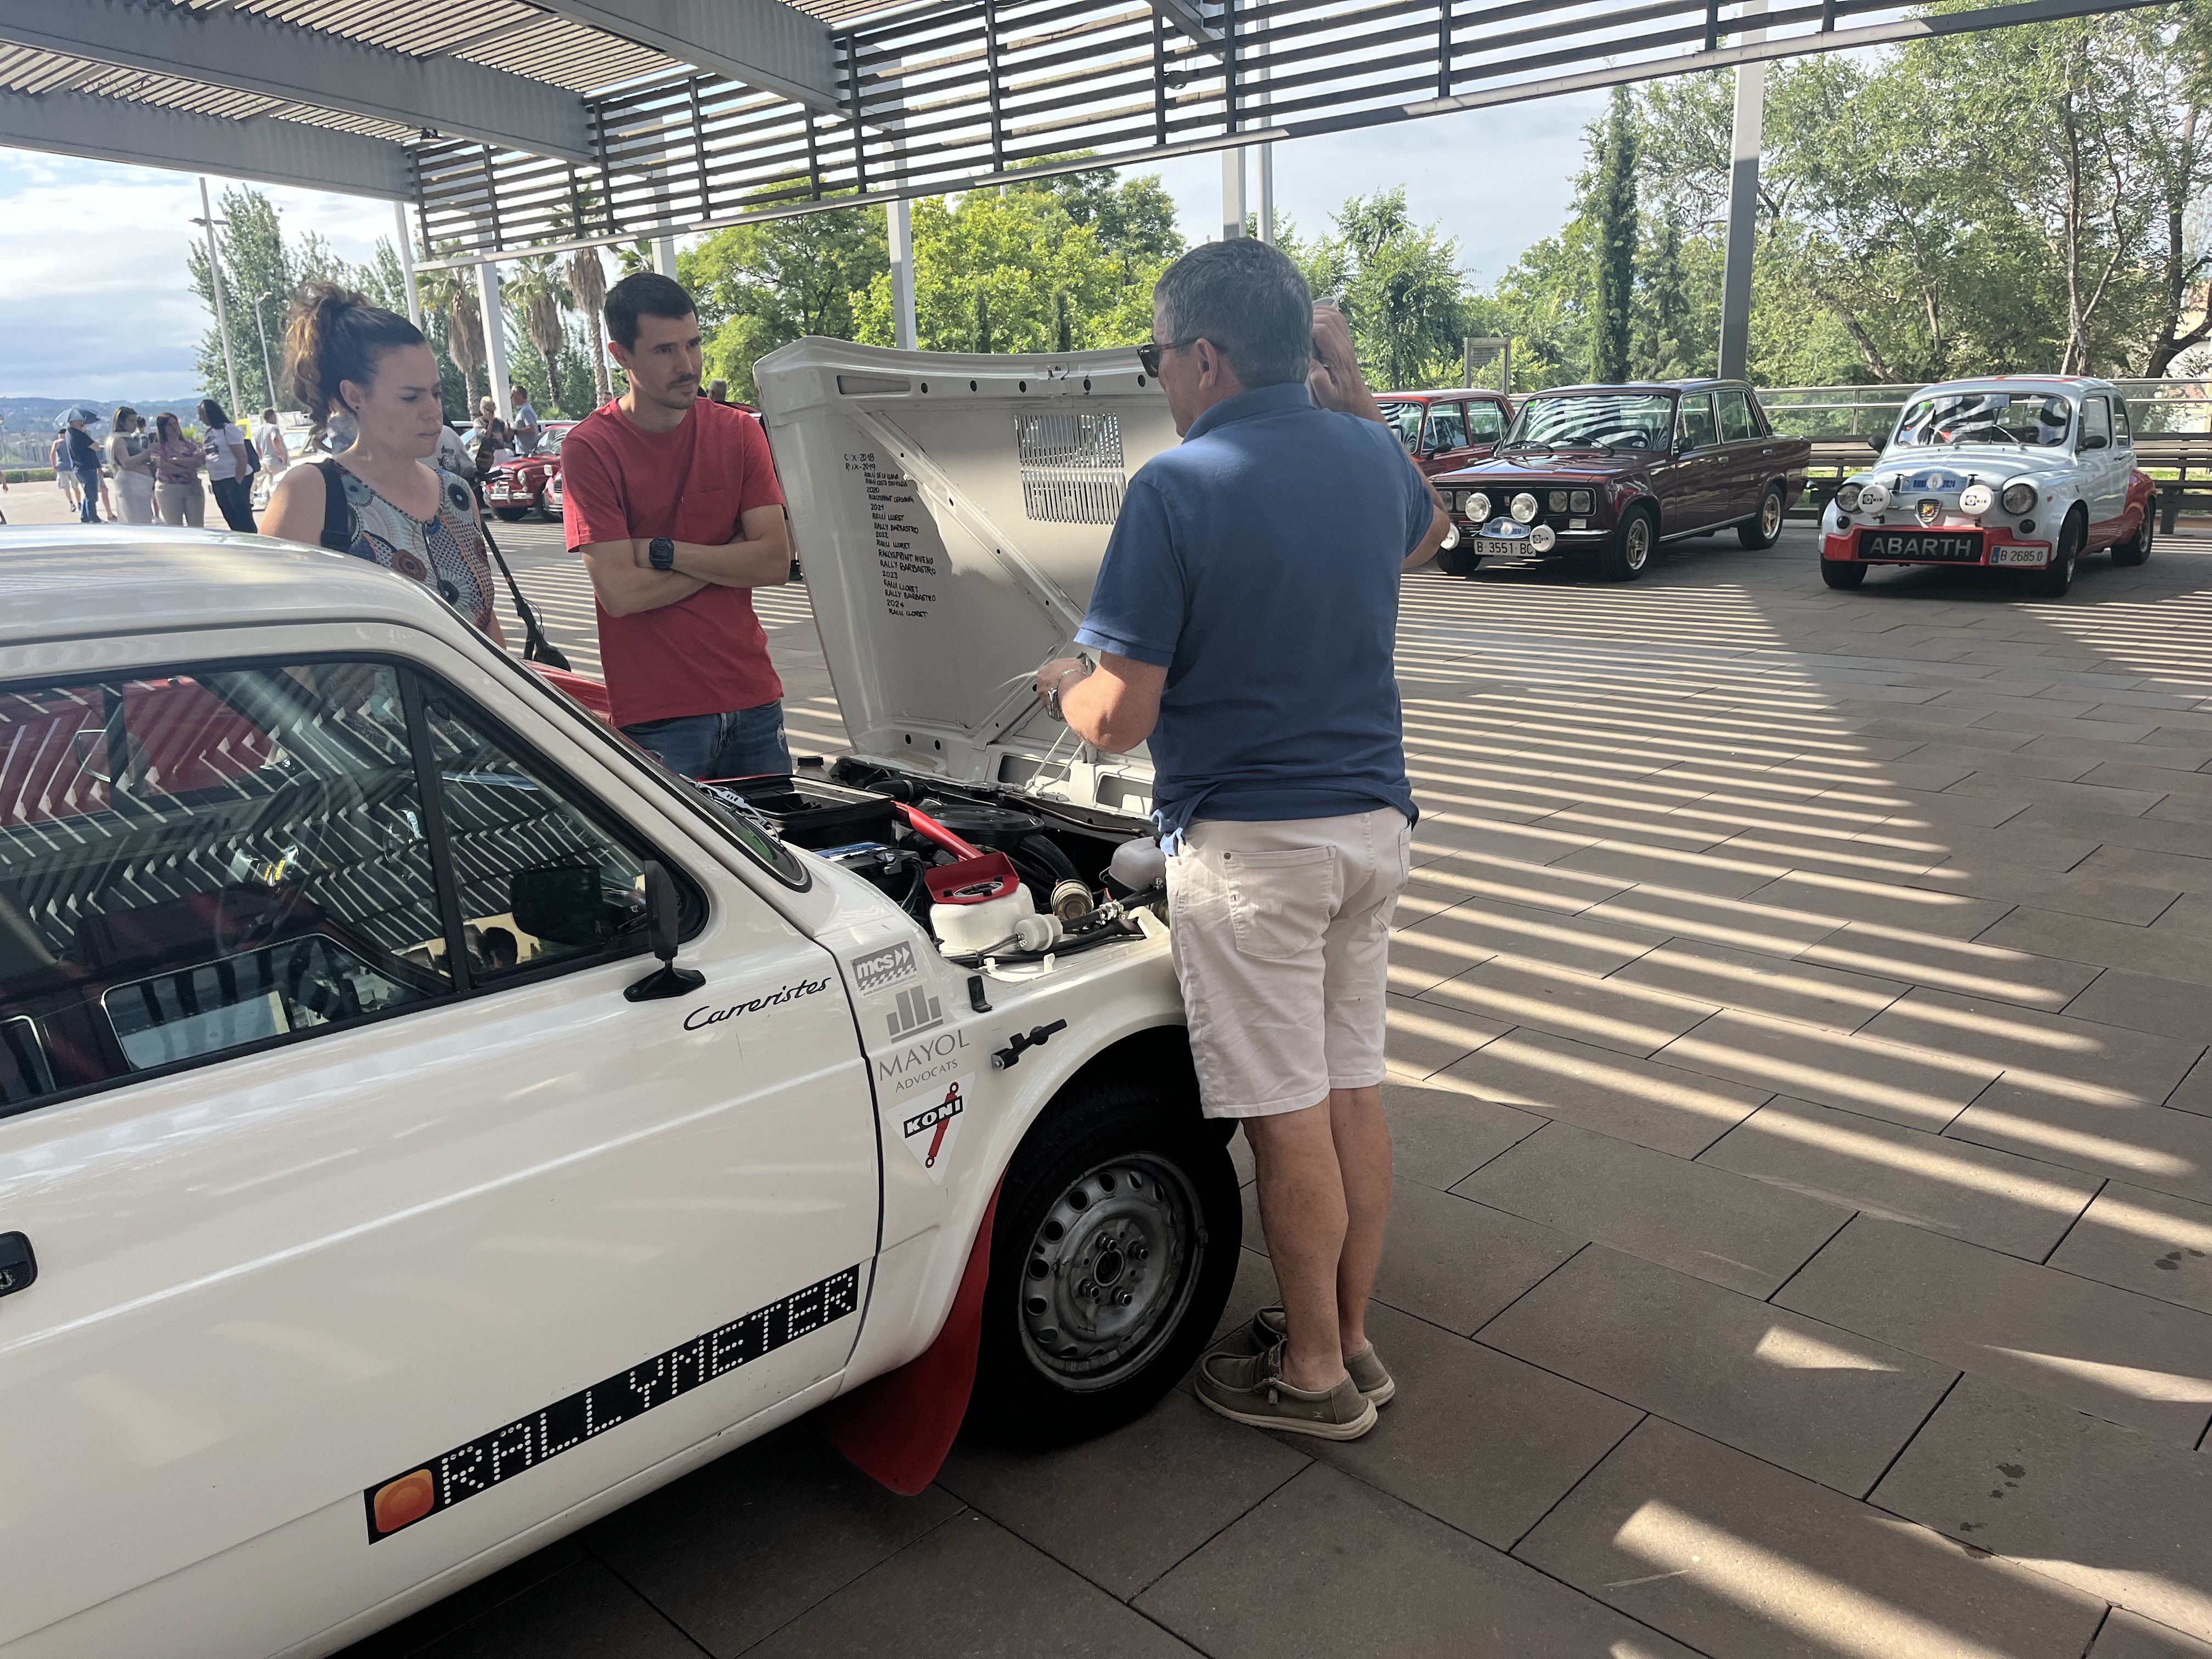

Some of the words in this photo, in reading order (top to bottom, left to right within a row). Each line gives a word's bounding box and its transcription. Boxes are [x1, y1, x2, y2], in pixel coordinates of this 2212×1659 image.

[1942, 479, 1956, 488] 2024
[874, 522, 889, 531] RALLY
[893, 541, 911, 550] LLORET
[1869, 537, 1972, 557] ABARTH
[878, 549, 913, 562] RALLYSPRINT
[2000, 550, 2008, 561] B
[2010, 550, 2035, 562] 2685
[880, 560, 898, 568] RALLY
[899, 562, 936, 576] BARBASTRO
[882, 570, 898, 579] 2023
[899, 583, 918, 593] LLORET
[885, 589, 901, 599] RALLY
[904, 592, 936, 602] BARBASTRO
[887, 599, 904, 608] 2024
[856, 954, 895, 979] mcs
[684, 977, 832, 1030] Carreristes
[879, 1029, 970, 1081] MAYOL
[895, 1059, 958, 1093] ADVOCATS
[906, 1099, 961, 1135] KONI
[441, 1272, 854, 1505] RALLYMETER
